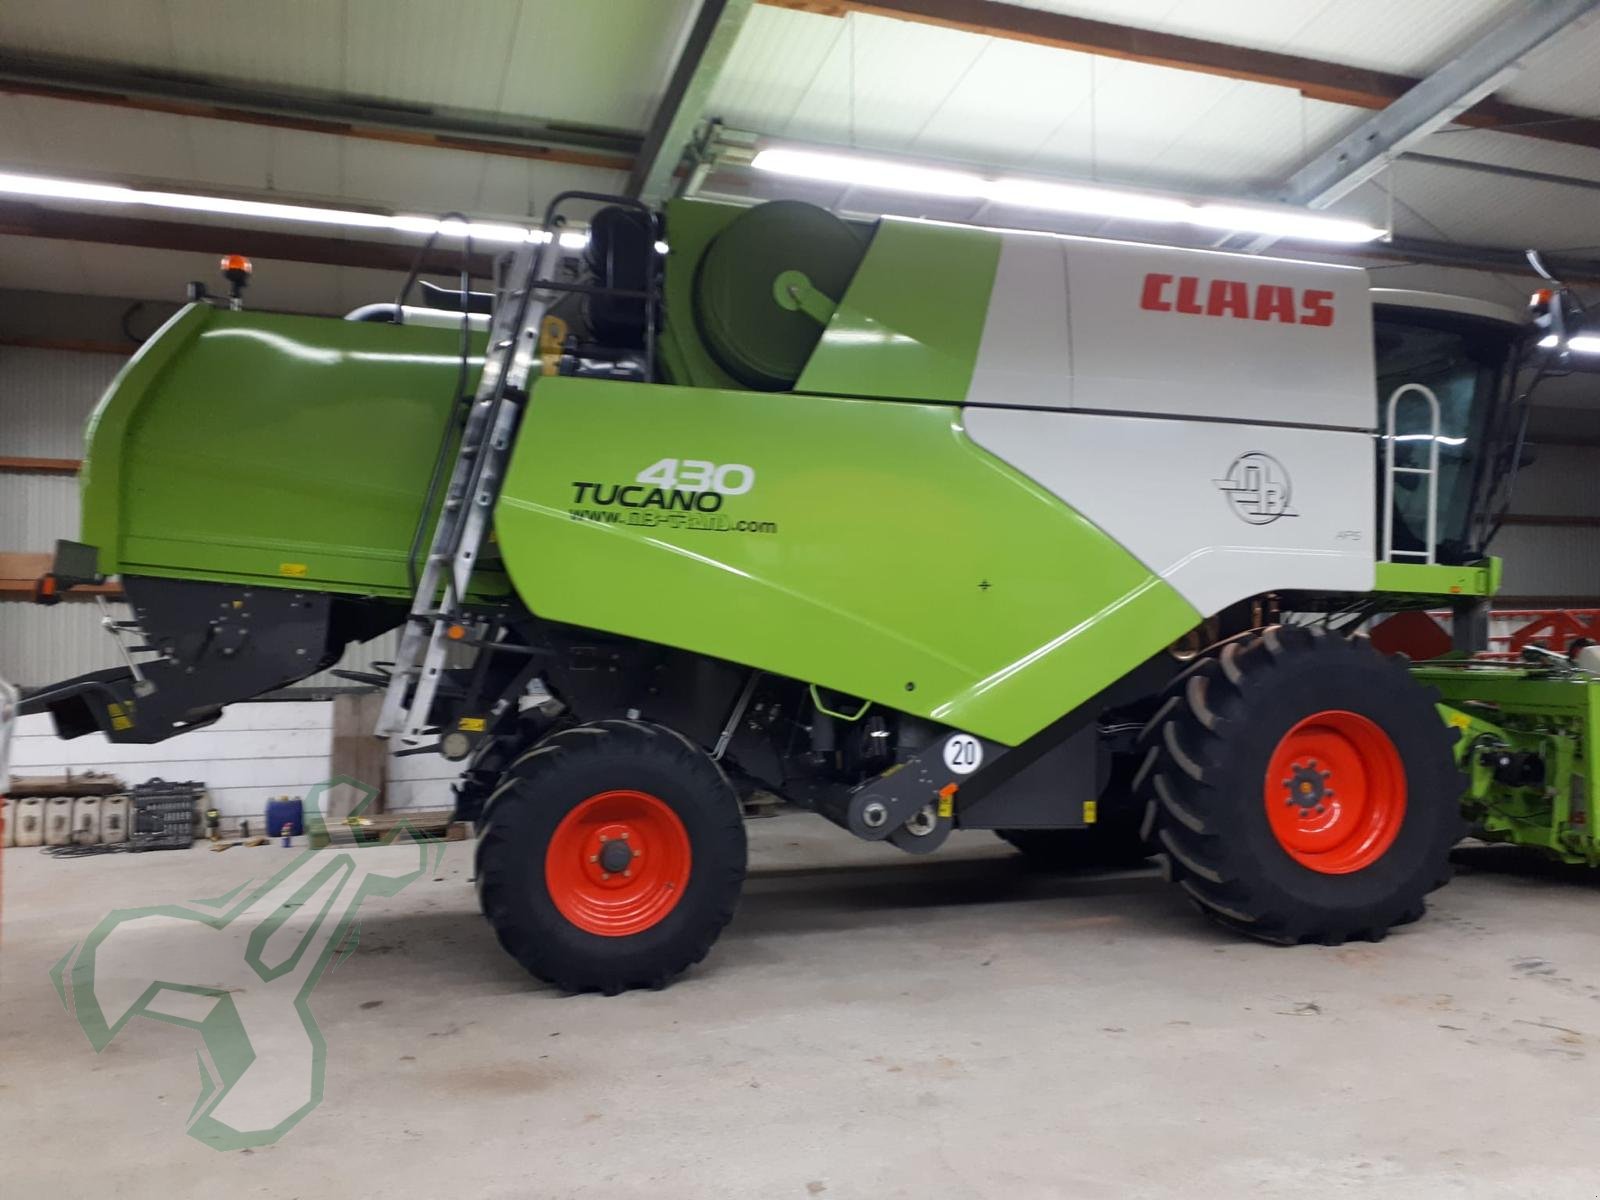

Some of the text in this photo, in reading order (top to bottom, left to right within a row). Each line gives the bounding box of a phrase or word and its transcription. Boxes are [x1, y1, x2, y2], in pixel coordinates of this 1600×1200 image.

[1140, 273, 1334, 327] CLAAS
[635, 458, 755, 495] 430
[571, 481, 724, 513] TUCANO
[951, 740, 976, 766] 20
